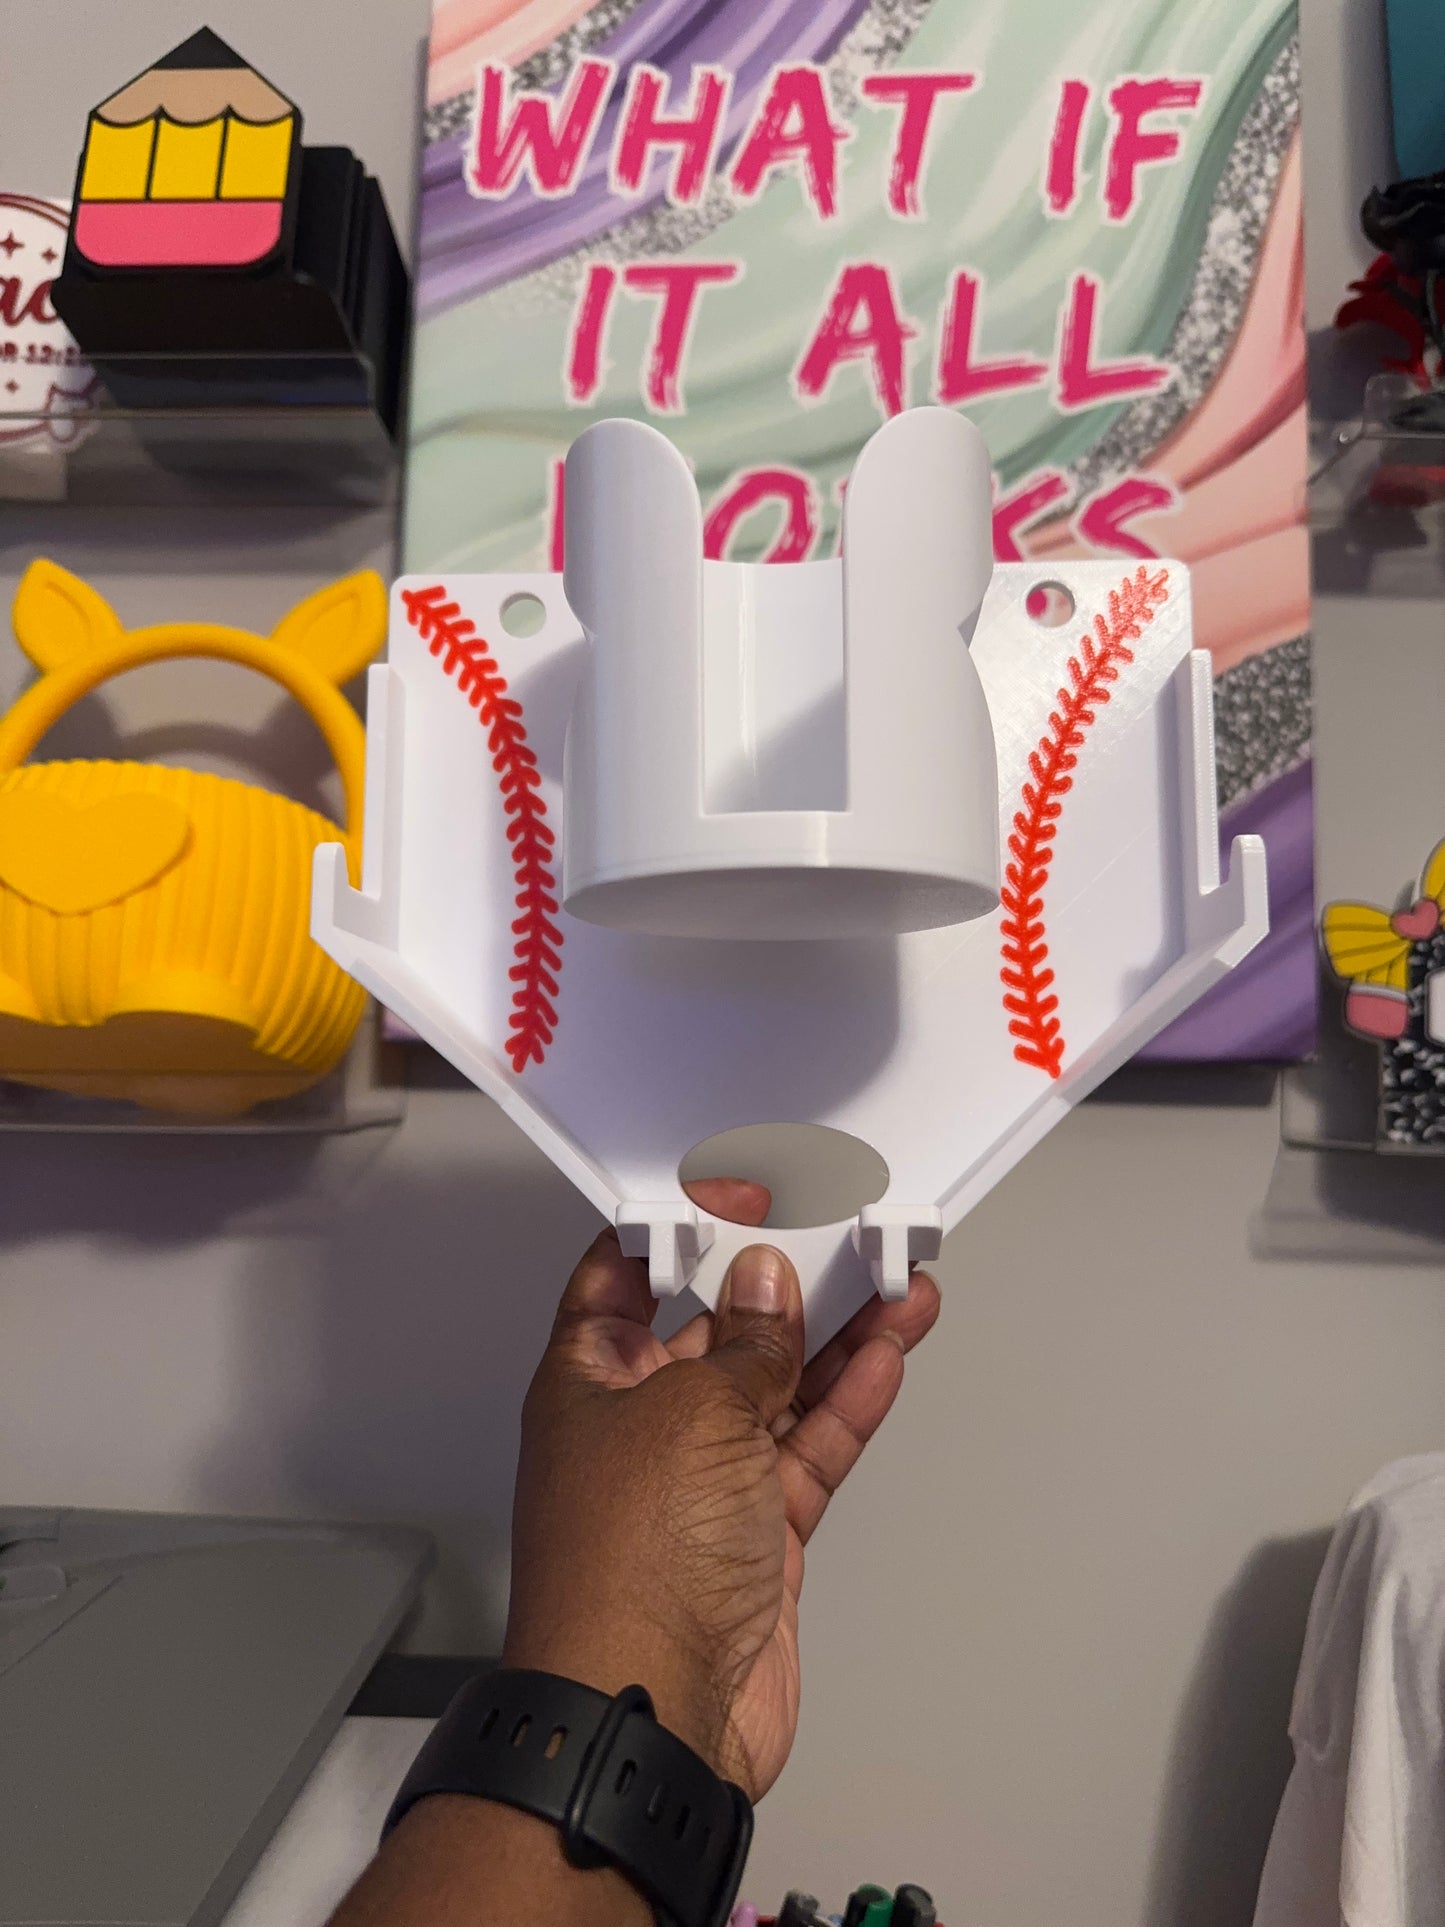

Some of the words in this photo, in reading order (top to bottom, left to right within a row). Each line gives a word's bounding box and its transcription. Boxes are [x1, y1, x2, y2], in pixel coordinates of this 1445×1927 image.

[470, 61, 975, 217] WHAT
[1044, 78, 1202, 220] IF
[568, 263, 737, 408] IT
[797, 262, 1168, 417] ALL
